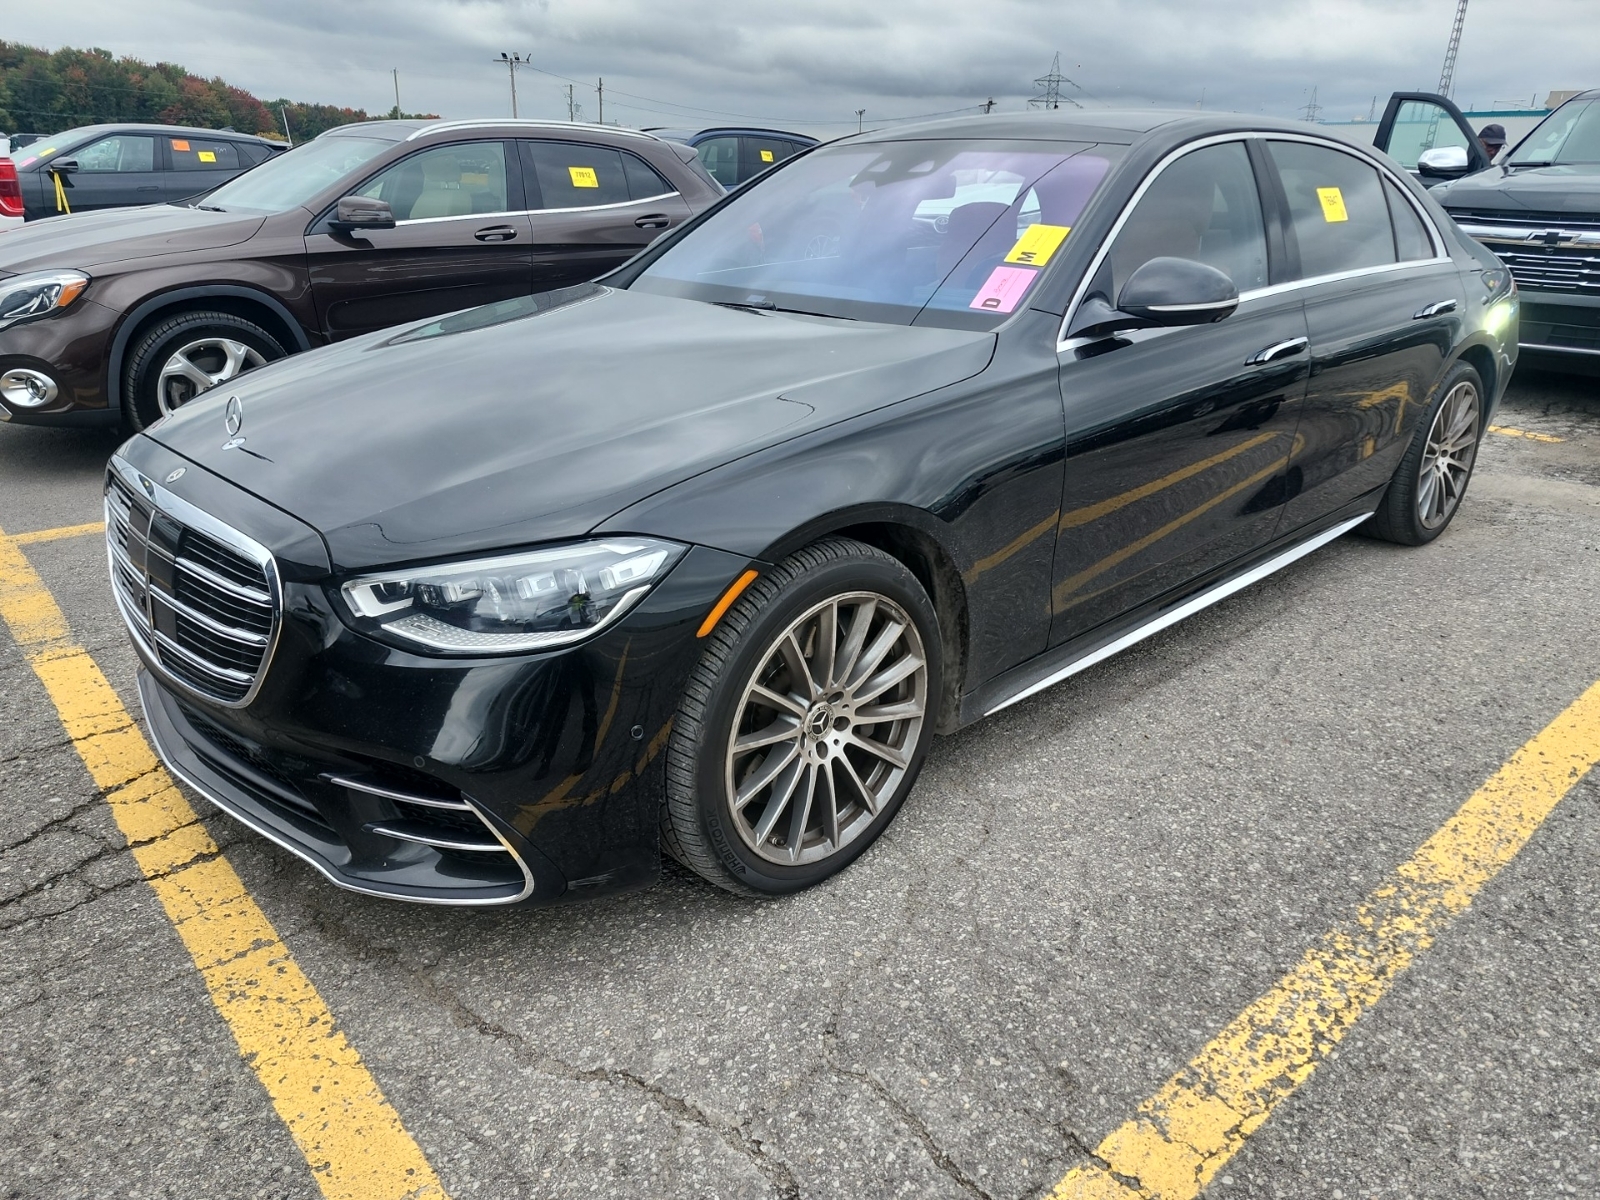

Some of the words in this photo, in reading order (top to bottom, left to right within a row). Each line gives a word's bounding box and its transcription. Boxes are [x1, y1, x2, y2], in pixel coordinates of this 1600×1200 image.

[1016, 251, 1037, 262] M
[981, 298, 1001, 309] D
[706, 808, 743, 872] HANKOOK
